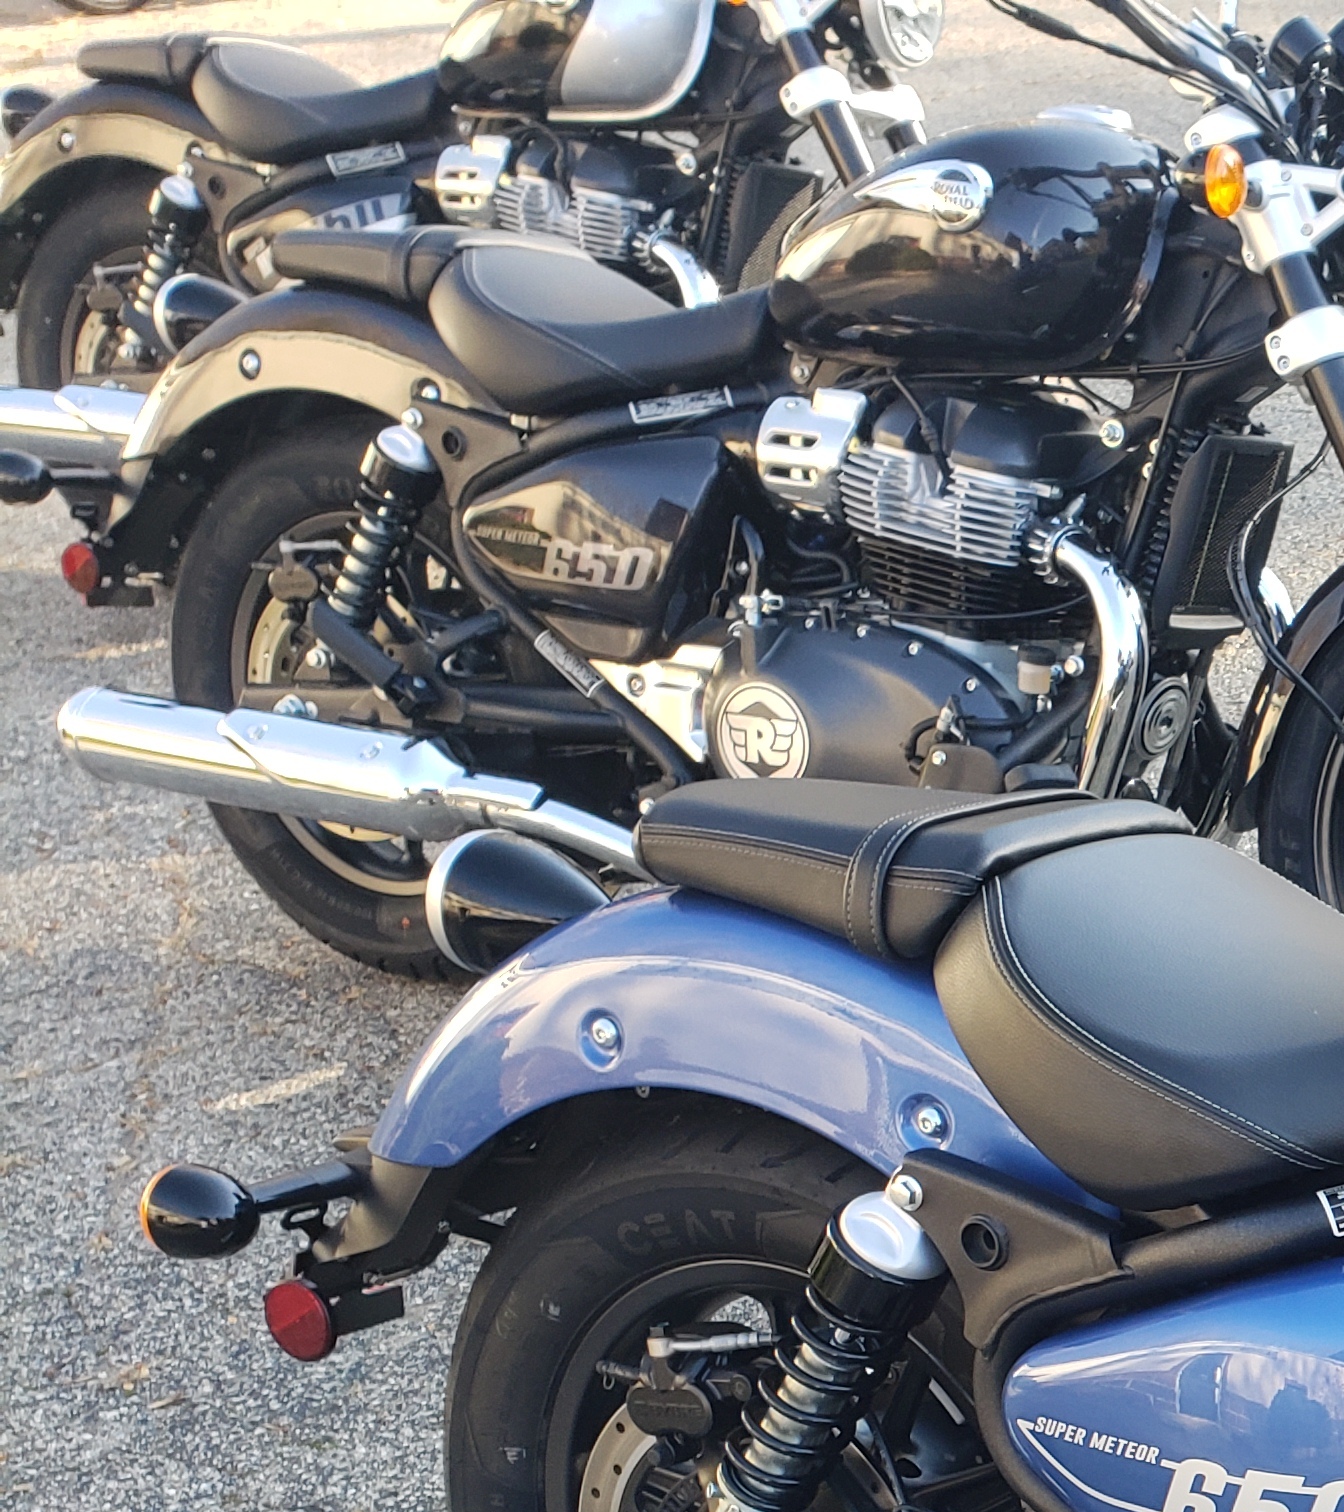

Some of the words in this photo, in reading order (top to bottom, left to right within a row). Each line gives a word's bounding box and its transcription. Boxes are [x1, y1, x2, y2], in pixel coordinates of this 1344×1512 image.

[541, 537, 655, 591] 650
[617, 1208, 736, 1256] CEAT
[1033, 1416, 1087, 1446] SUPER
[1089, 1432, 1161, 1465] METEOR
